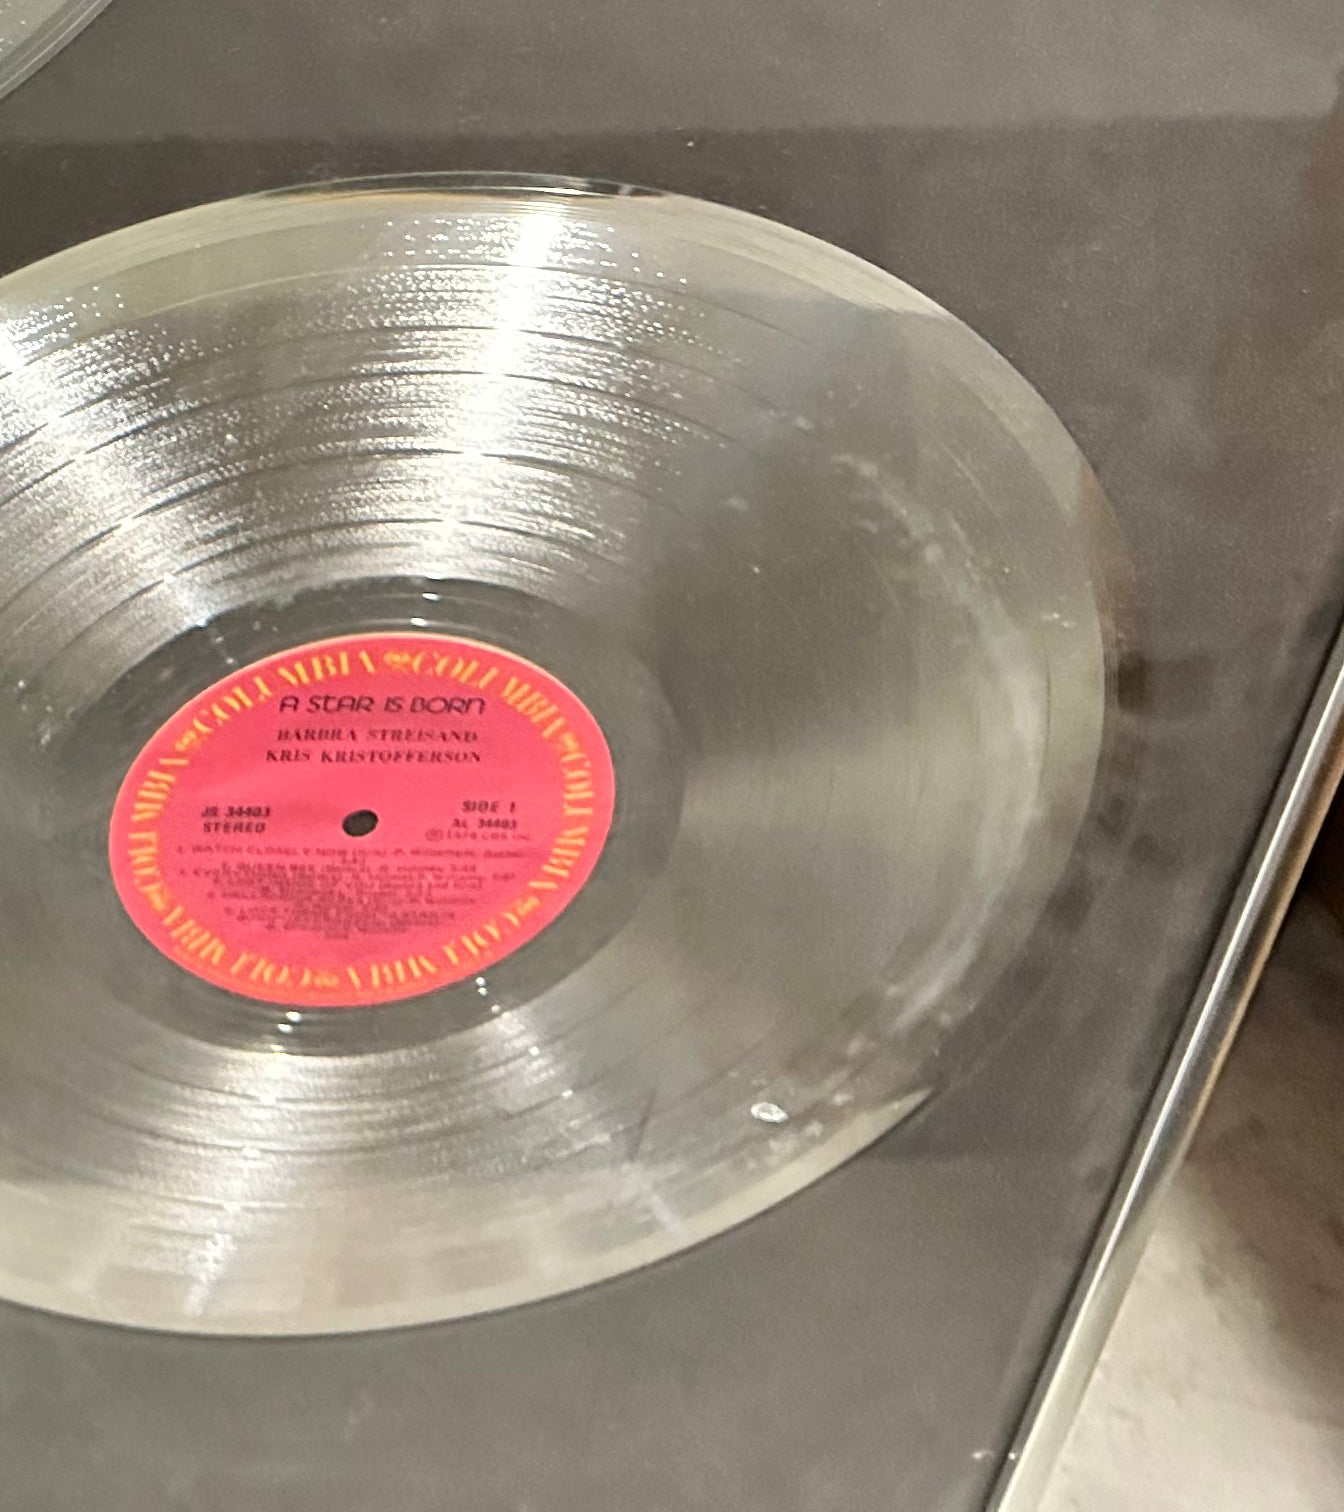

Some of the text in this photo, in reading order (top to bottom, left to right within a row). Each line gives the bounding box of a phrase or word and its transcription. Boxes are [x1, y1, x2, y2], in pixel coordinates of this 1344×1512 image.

[193, 650, 375, 736] COLUMBIA
[279, 695, 299, 713] A
[384, 696, 404, 712] IS
[412, 650, 567, 738] COLUMBIA
[266, 749, 310, 762] KRIS
[128, 758, 188, 895] COLUMBIA
[529, 754, 595, 892] COLUMBIA
[160, 905, 312, 989] COLUMBIA
[347, 912, 519, 988] COLUMBIA
